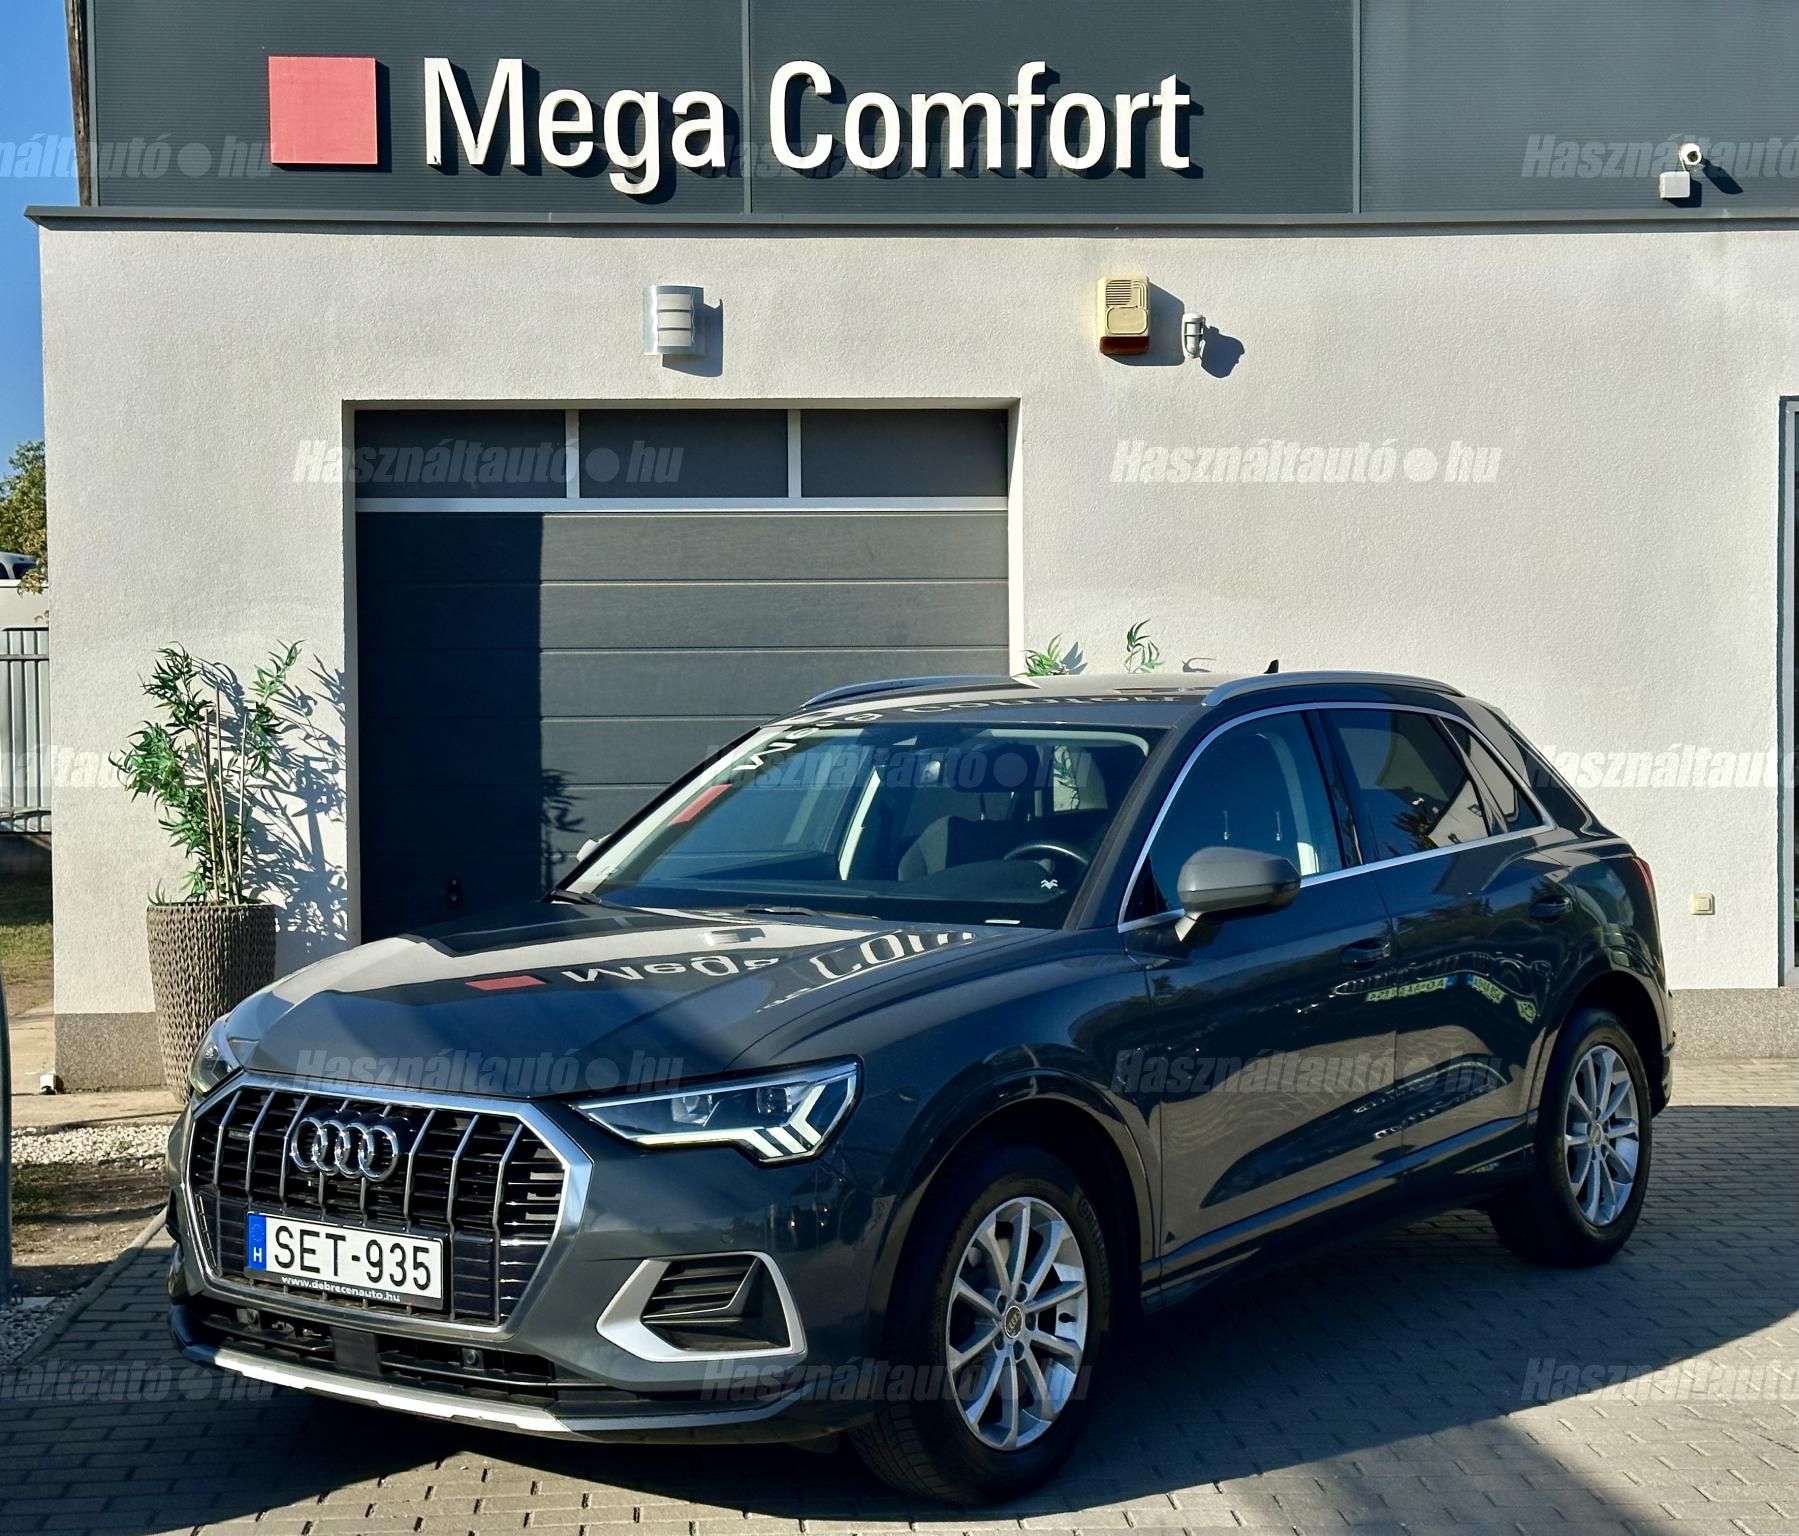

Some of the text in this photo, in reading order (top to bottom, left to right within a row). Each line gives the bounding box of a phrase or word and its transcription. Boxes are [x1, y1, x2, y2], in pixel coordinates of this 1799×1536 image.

[424, 57, 1191, 195] Mega Comfort
[253, 1247, 263, 1264] H
[274, 1225, 431, 1291] SET-935
[281, 1276, 401, 1302] www.debrecenauto.hu
